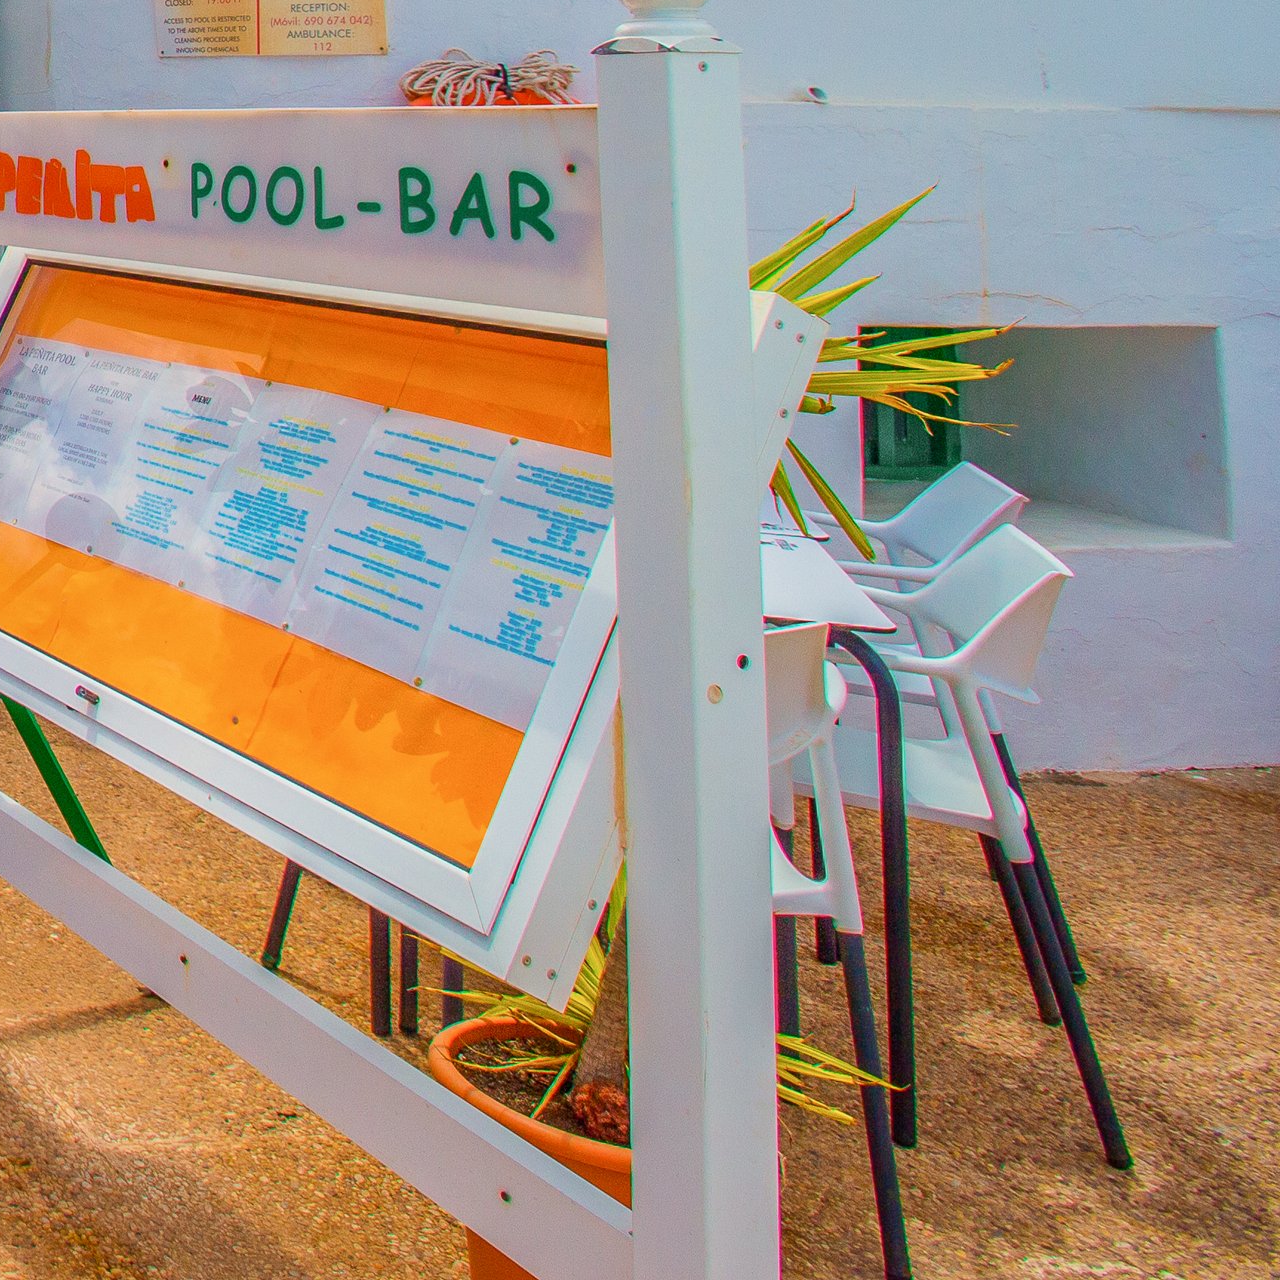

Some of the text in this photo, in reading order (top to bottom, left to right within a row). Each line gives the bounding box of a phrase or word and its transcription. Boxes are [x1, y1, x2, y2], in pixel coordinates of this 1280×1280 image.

[165, 0, 193, 7] CLOSED:
[291, 3, 350, 12] RECEPTION:
[270, 15, 373, 27] (Móvil: 690 674 042)
[287, 29, 355, 39] AMBULANCE:
[314, 42, 332, 51] 112
[20, 346, 76, 366] LA PEÑITA POOL
[32, 364, 48, 375] BAR
[90, 360, 158, 380] LA PEÑITA POOL BAR
[88, 384, 109, 395] HAPPY
[110, 390, 132, 401] HOUR
[192, 394, 212, 405] MENU
